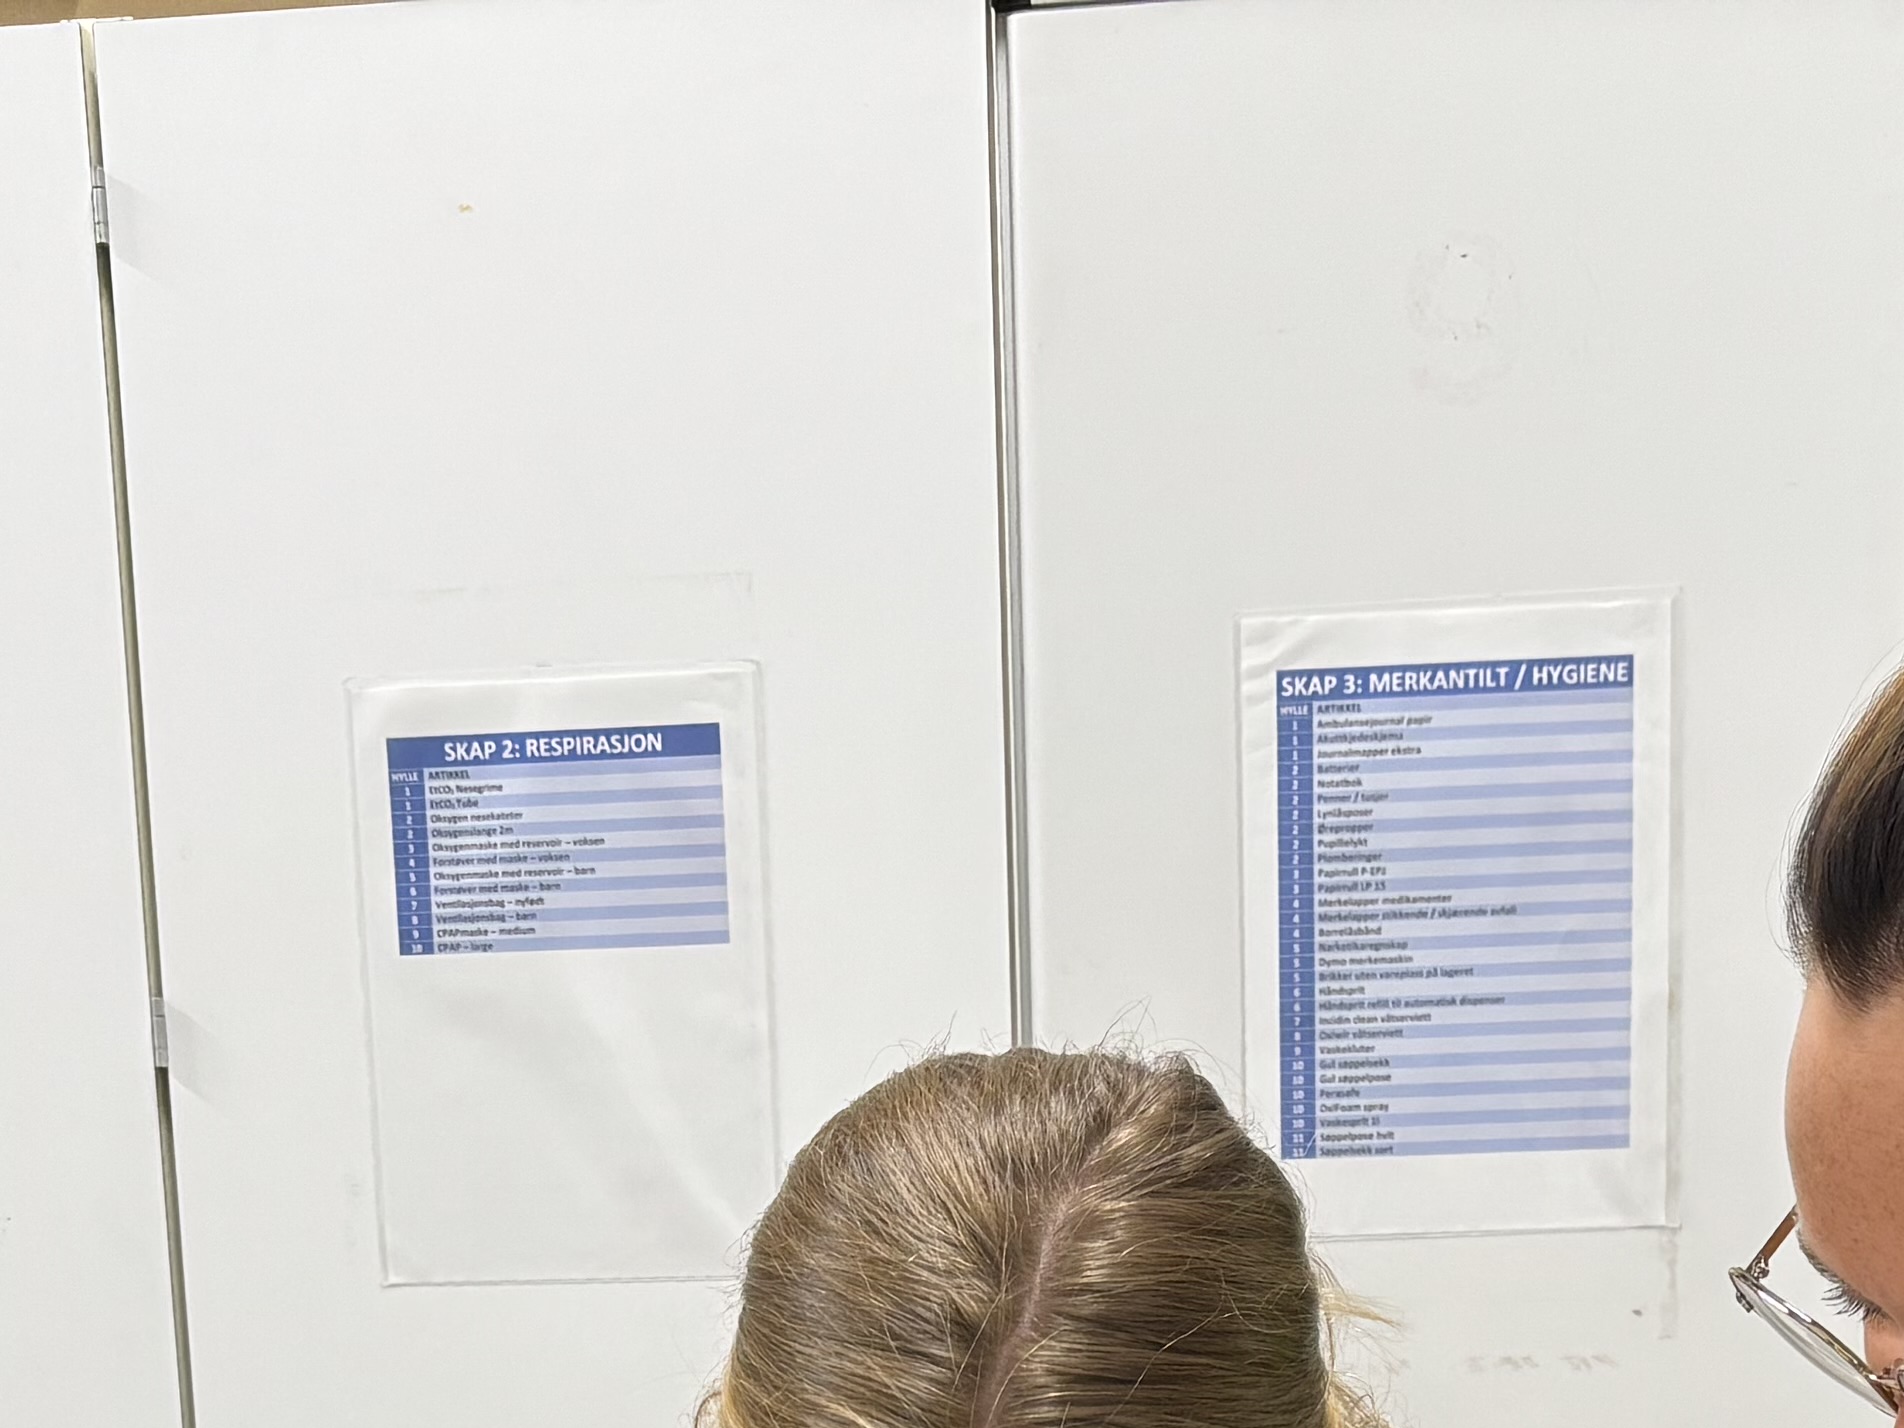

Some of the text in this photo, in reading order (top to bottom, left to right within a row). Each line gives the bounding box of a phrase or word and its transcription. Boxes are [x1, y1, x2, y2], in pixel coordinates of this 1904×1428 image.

[1280, 674, 1337, 698] SKAP
[1341, 673, 1362, 695] 3:
[1367, 665, 1510, 694] MERKANTILT
[1531, 660, 1629, 686] HYGIENE
[442, 731, 663, 762] SKAP 2: RESPIRASJON
